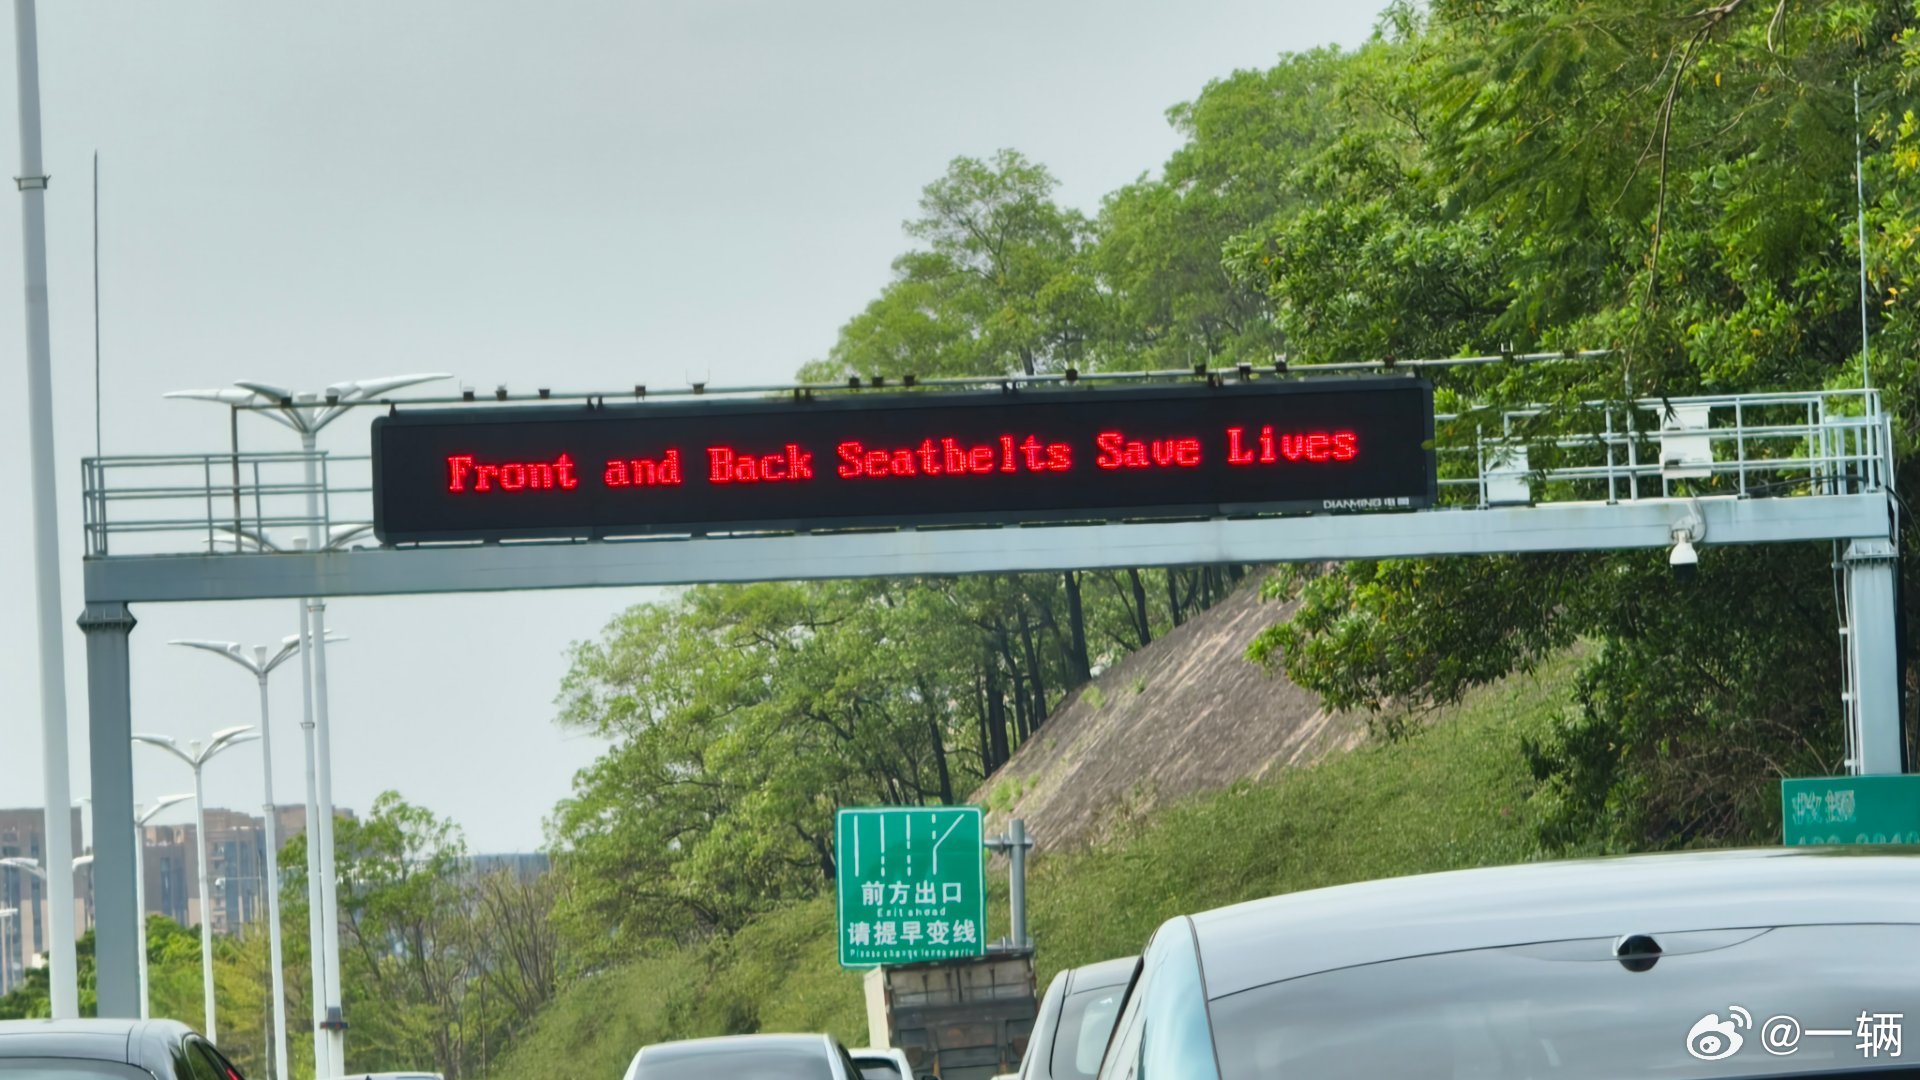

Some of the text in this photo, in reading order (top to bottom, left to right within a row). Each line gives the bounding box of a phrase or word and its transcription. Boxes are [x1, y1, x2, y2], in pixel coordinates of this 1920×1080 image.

[448, 426, 1358, 491] Front and Back Seatbelts Save Lives
[861, 880, 962, 906] 前方出口
[848, 918, 977, 946] 请提早变线
